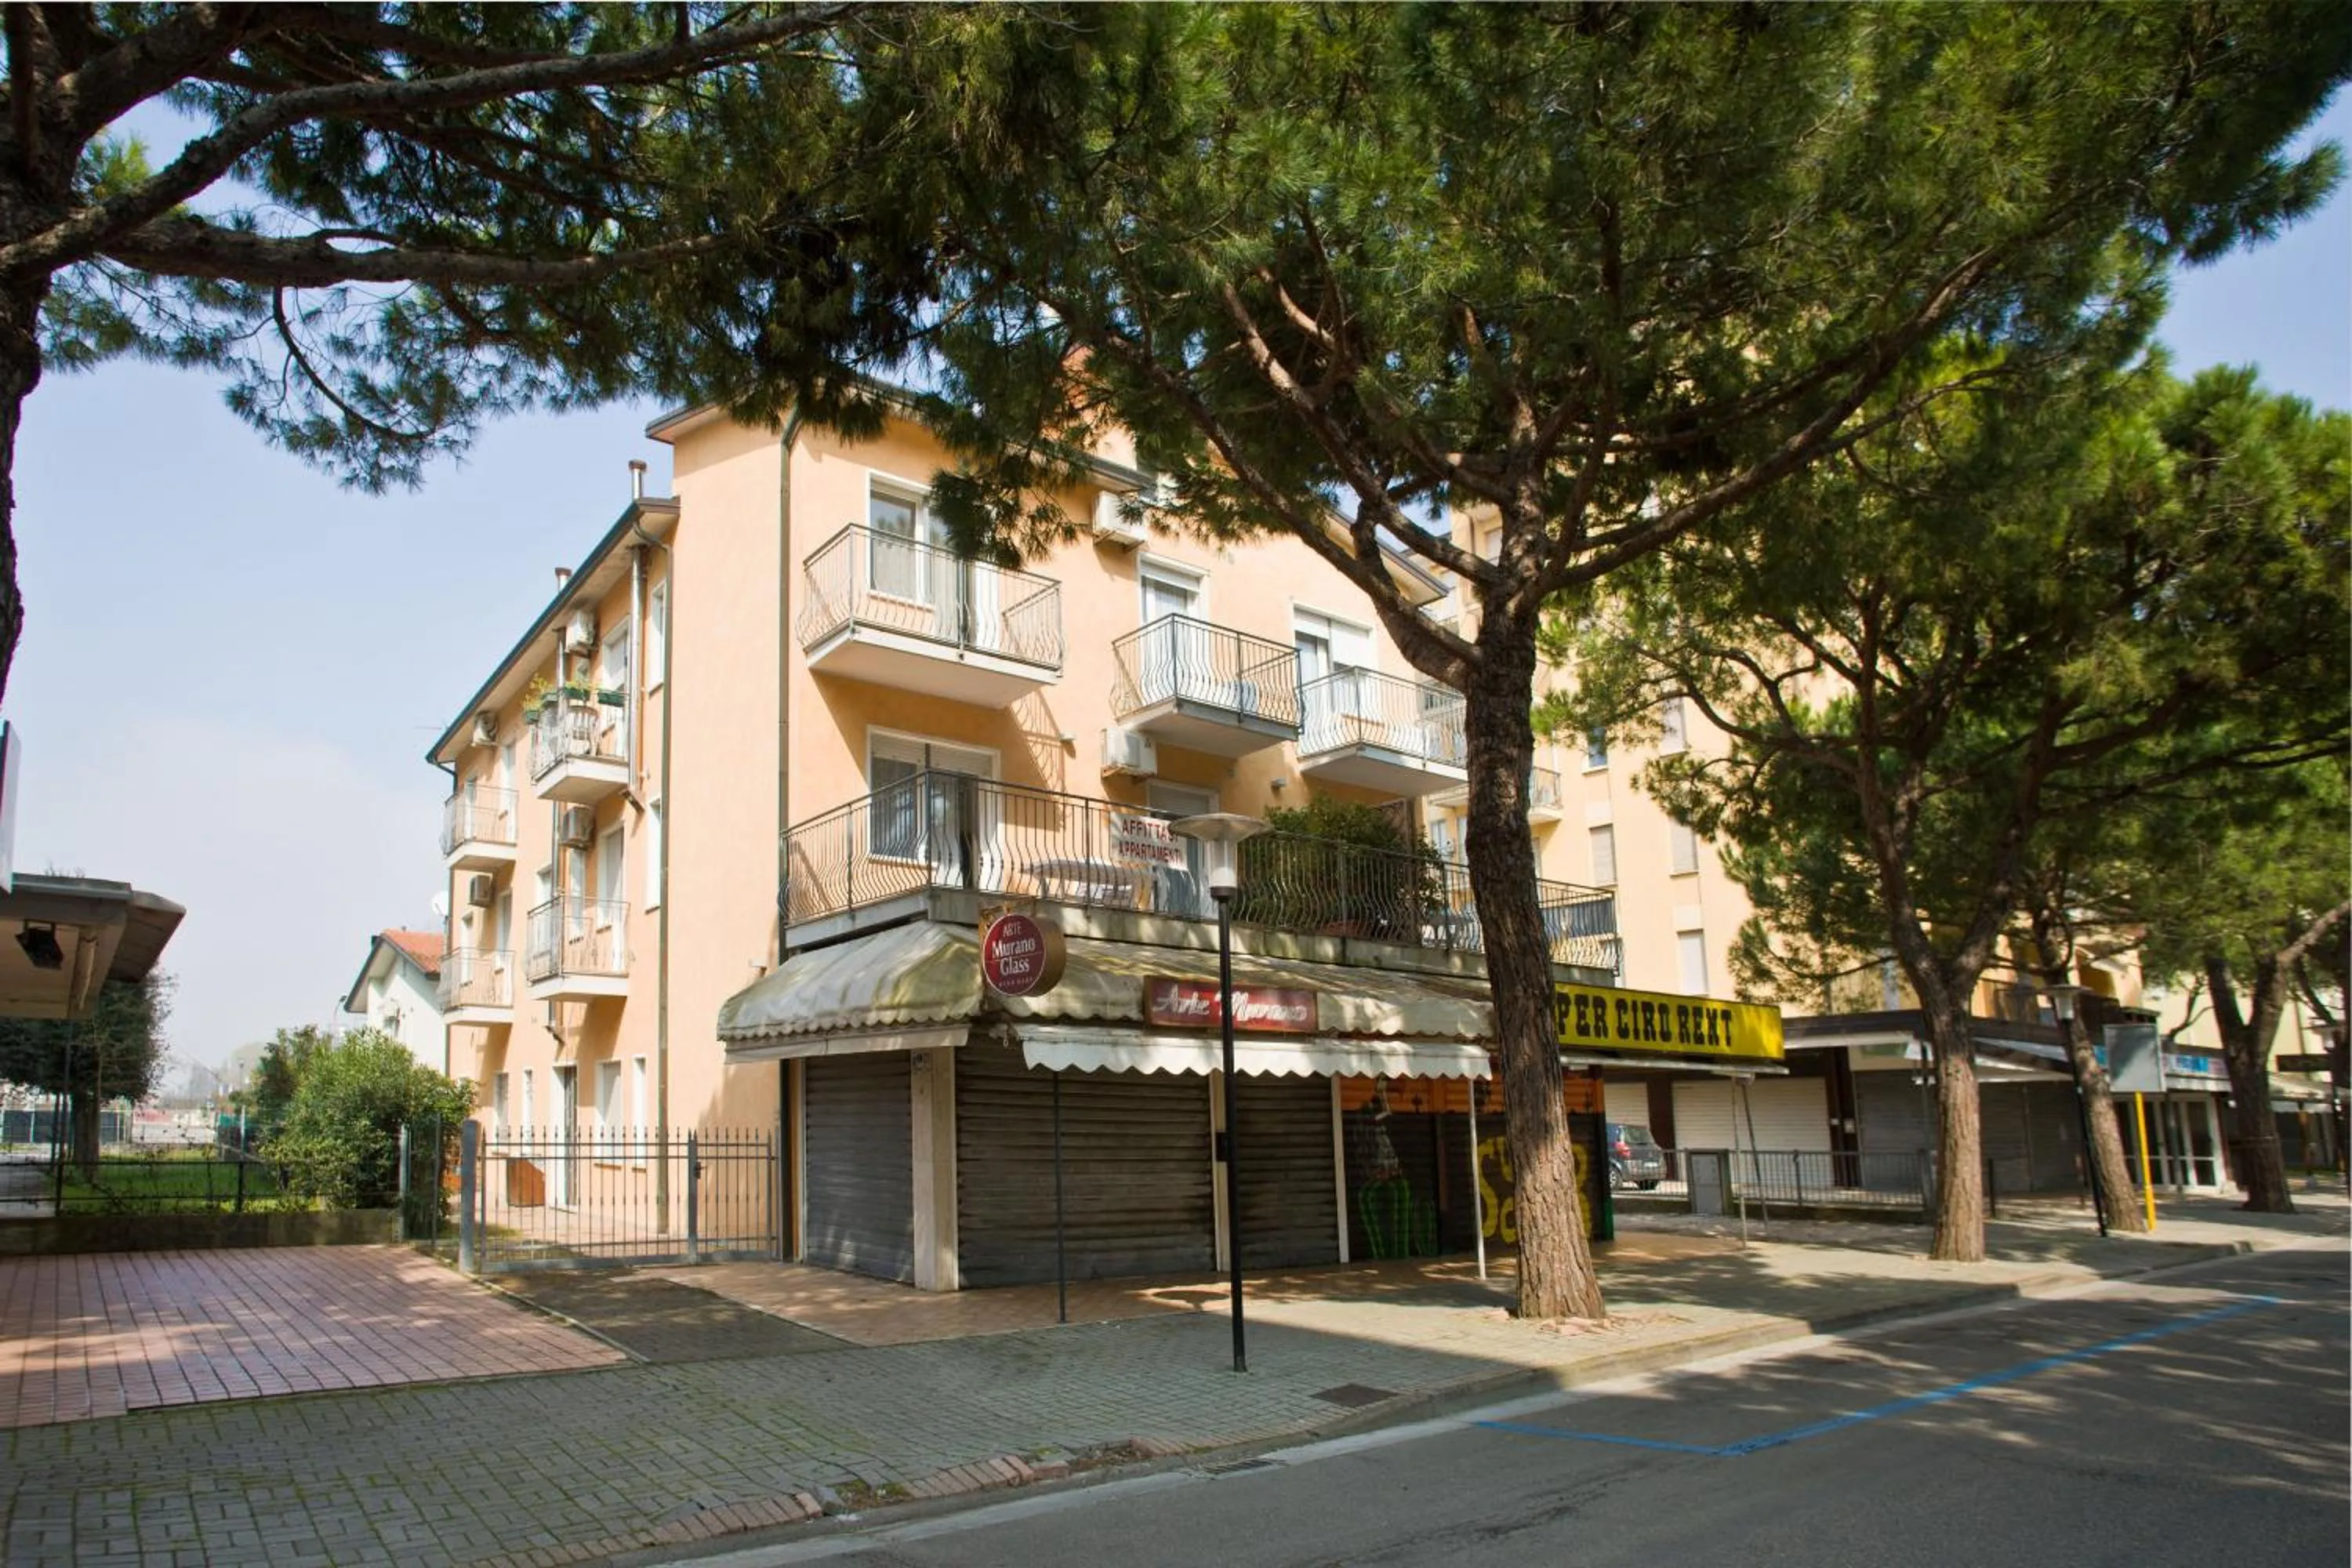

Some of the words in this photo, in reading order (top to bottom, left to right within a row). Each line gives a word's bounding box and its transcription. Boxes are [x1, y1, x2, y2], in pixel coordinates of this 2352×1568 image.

[1003, 921, 1022, 938] ARTE
[992, 938, 1036, 959] Murano
[1000, 956, 1030, 975] Glass
[1152, 984, 1210, 1015] Arte
[1615, 999, 1671, 1042] CIRO
[1677, 1005, 1732, 1047] RENT
